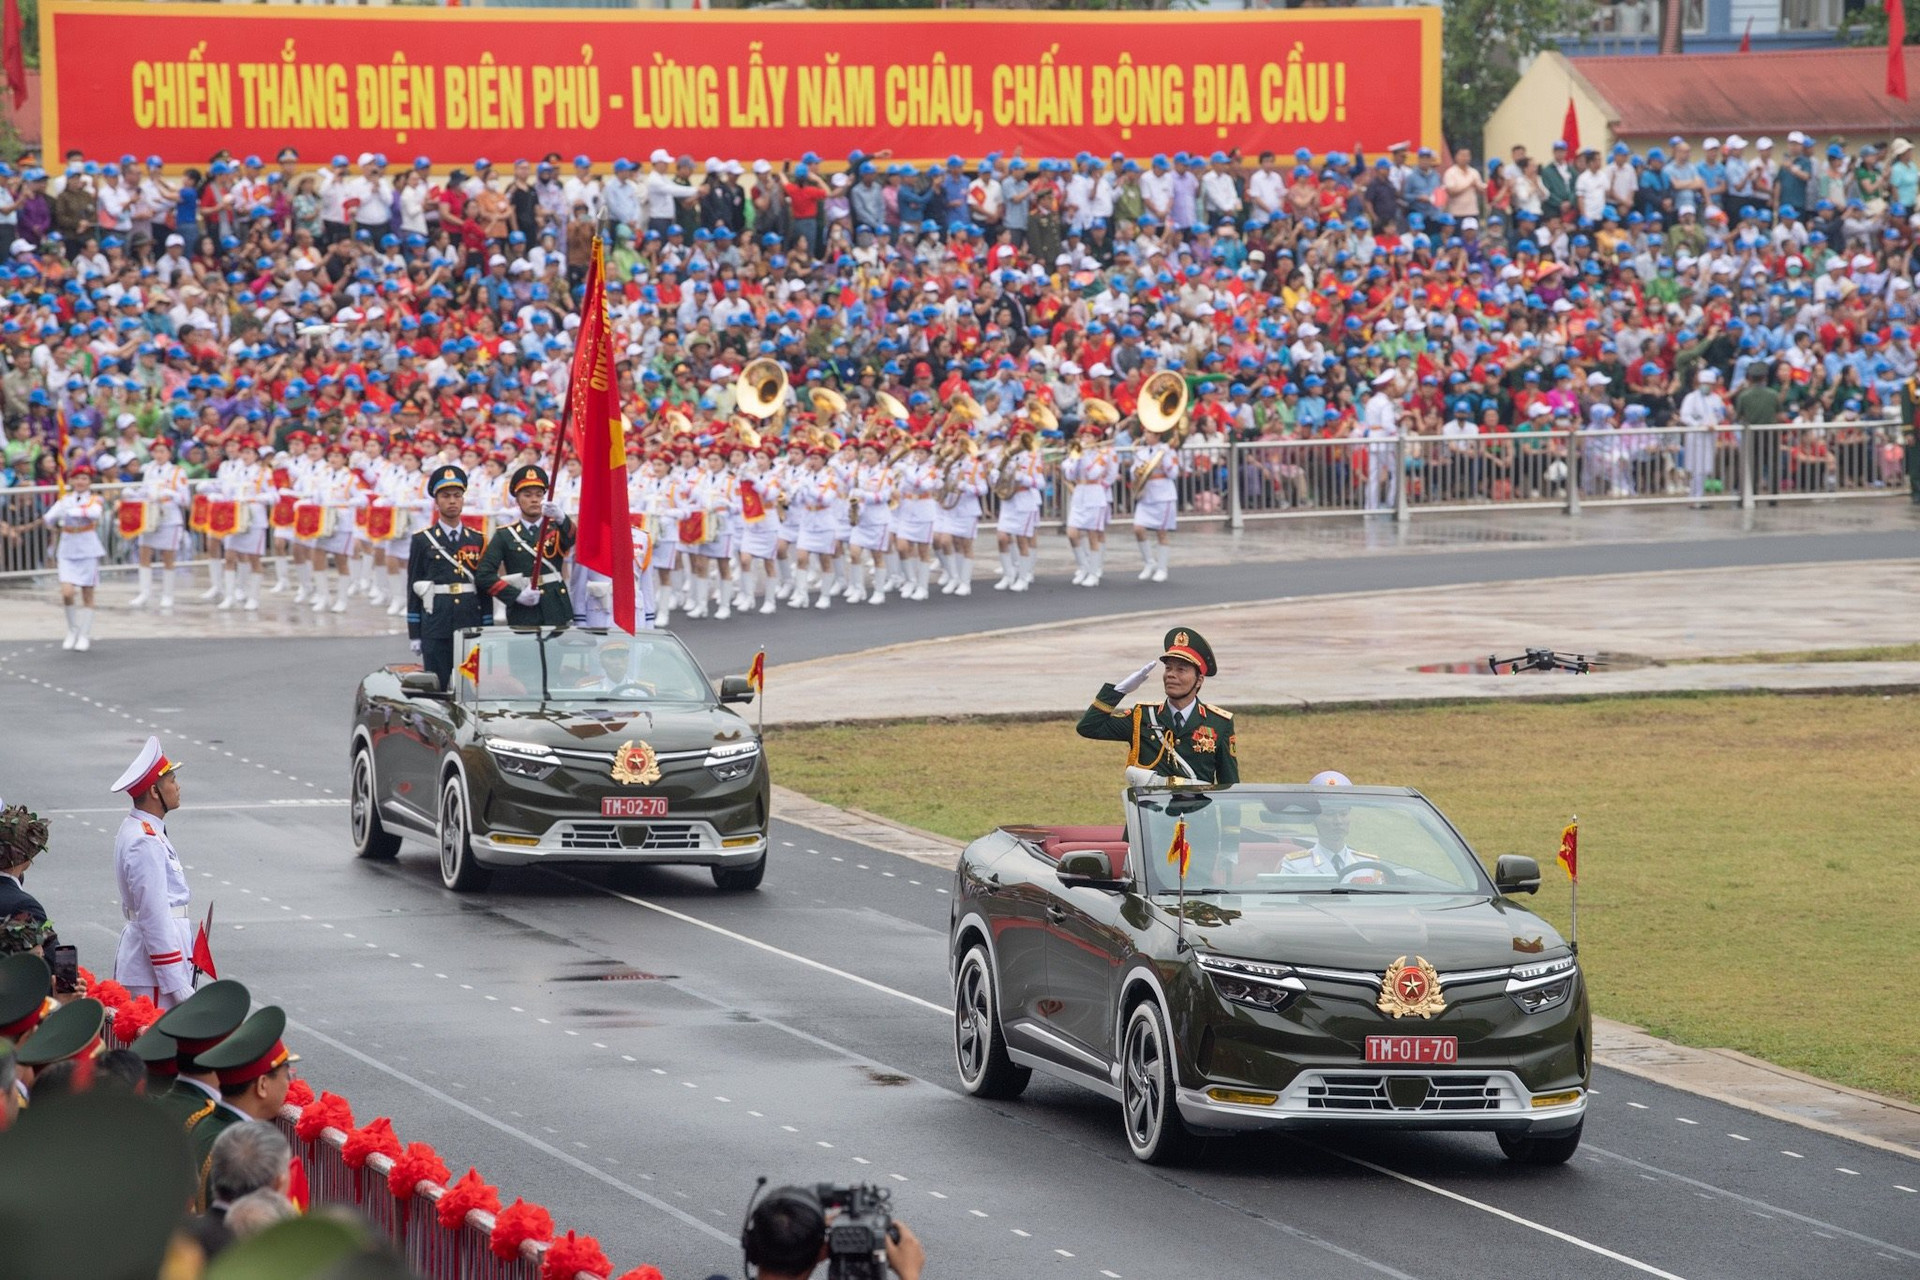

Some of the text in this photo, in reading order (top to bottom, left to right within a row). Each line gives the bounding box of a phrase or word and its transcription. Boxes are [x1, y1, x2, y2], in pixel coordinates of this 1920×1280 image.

[132, 40, 232, 129] CHIẾN
[238, 38, 350, 130] THẮNG
[356, 50, 436, 144] ĐIỆN
[444, 51, 525, 130] BIÊN
[531, 44, 601, 129] PHỦ
[609, 94, 624, 109] -
[631, 51, 720, 129] LỪNG
[727, 41, 788, 128] LẪY
[797, 53, 876, 128] NĂM
[885, 51, 984, 133] CHÂU,
[992, 43, 1084, 127] CHẤN
[1091, 51, 1185, 140] ĐỘNG
[1192, 63, 1252, 139] ĐỊA
[604, 799, 666, 815] TM-02-70
[1369, 1039, 1454, 1060] TM-01-70
